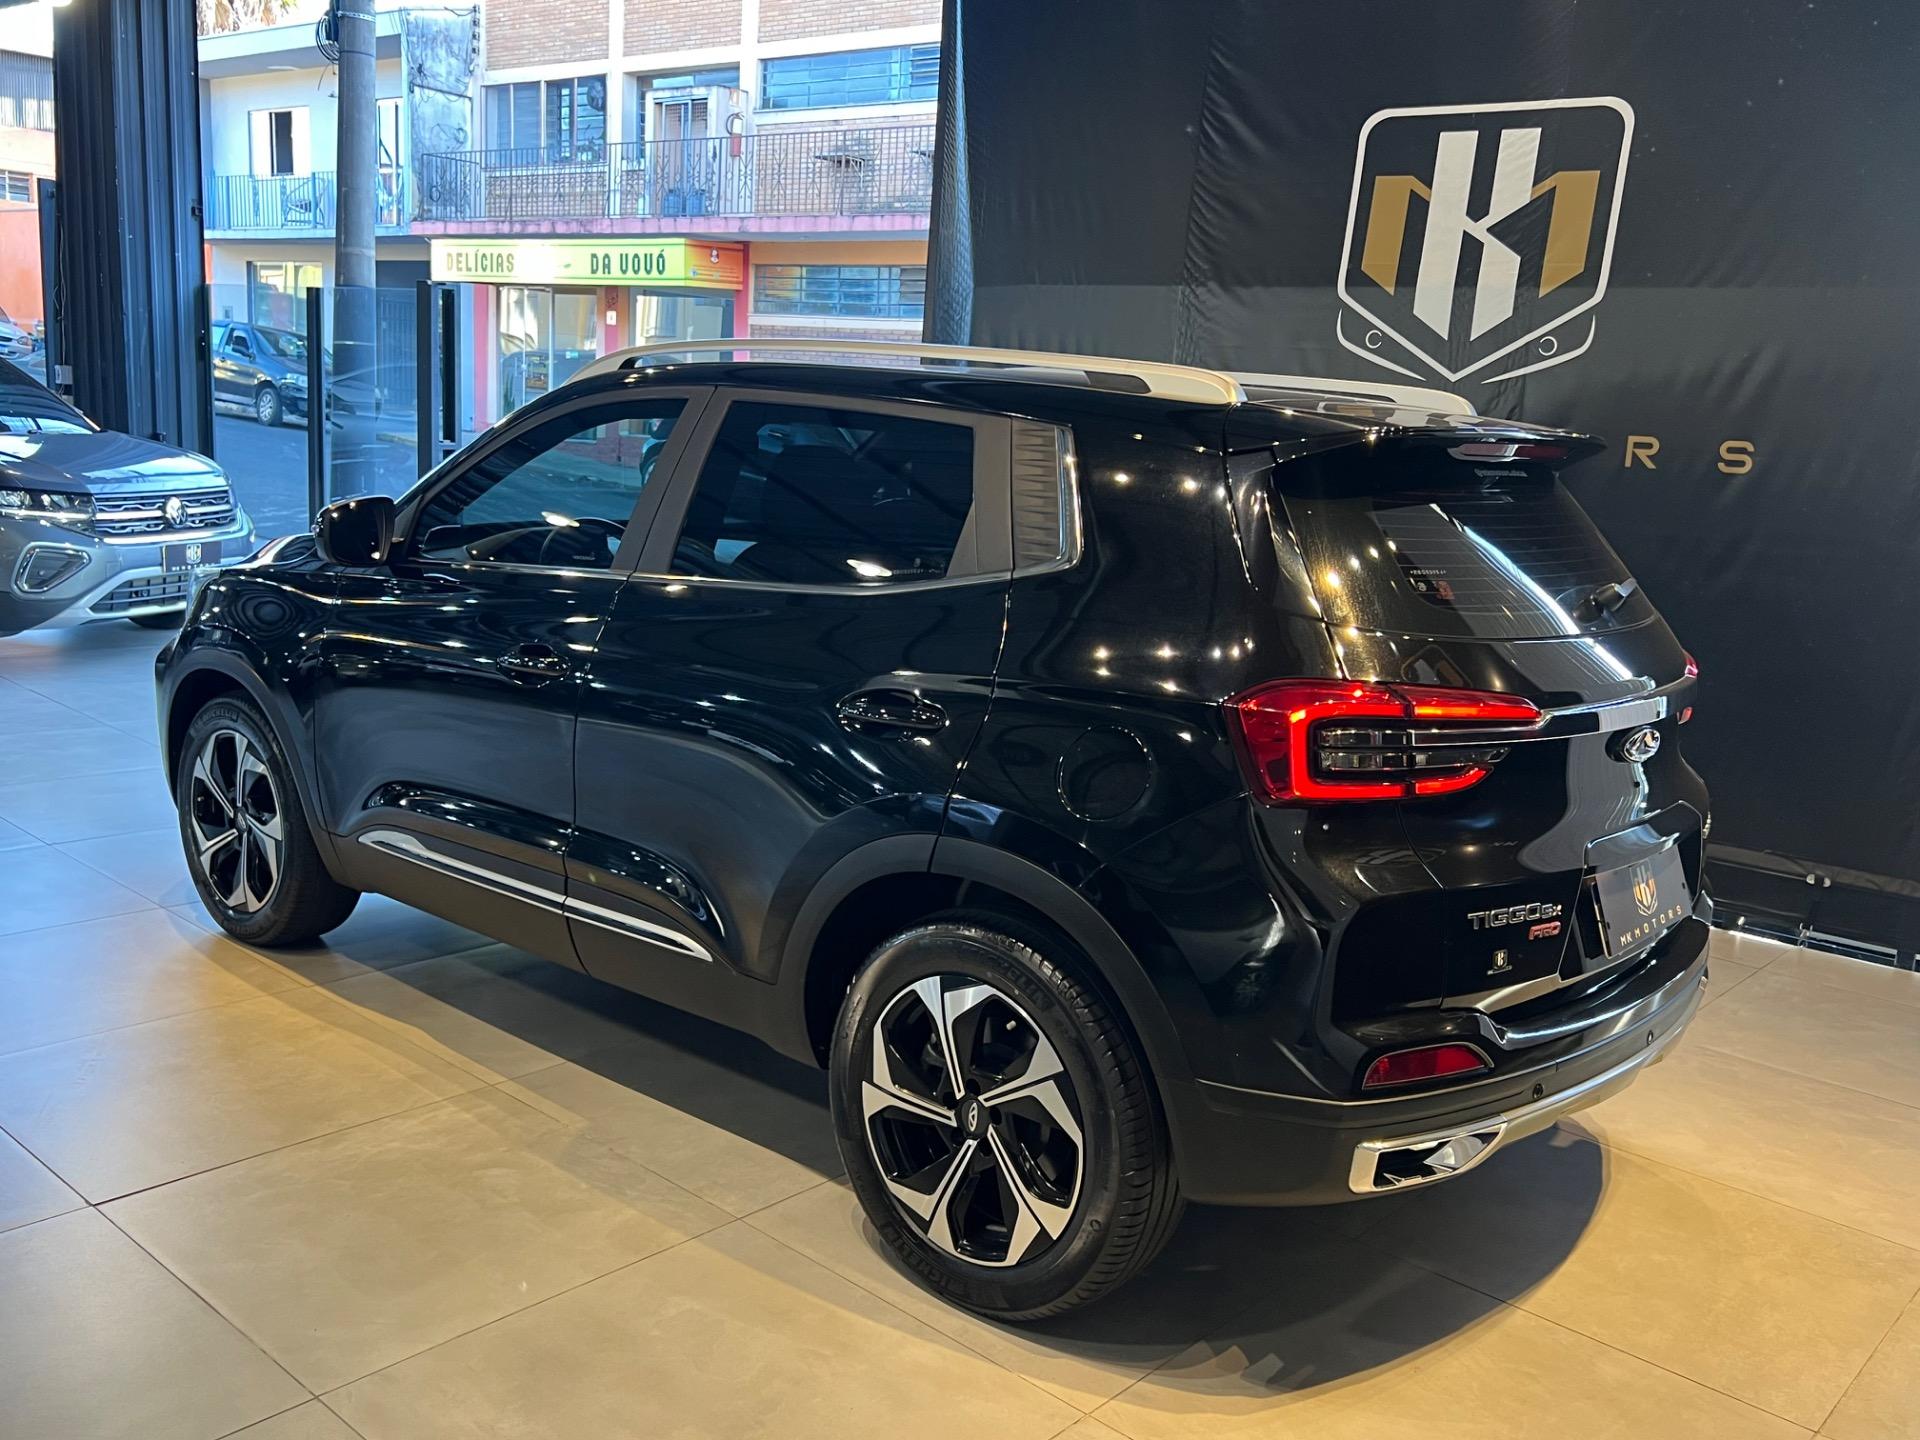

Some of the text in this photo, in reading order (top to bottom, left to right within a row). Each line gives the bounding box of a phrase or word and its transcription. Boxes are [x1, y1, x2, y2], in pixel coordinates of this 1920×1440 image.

[447, 249, 515, 273] DELÍCIAS
[590, 253, 611, 275] DA
[1528, 921, 1561, 940] PRO
